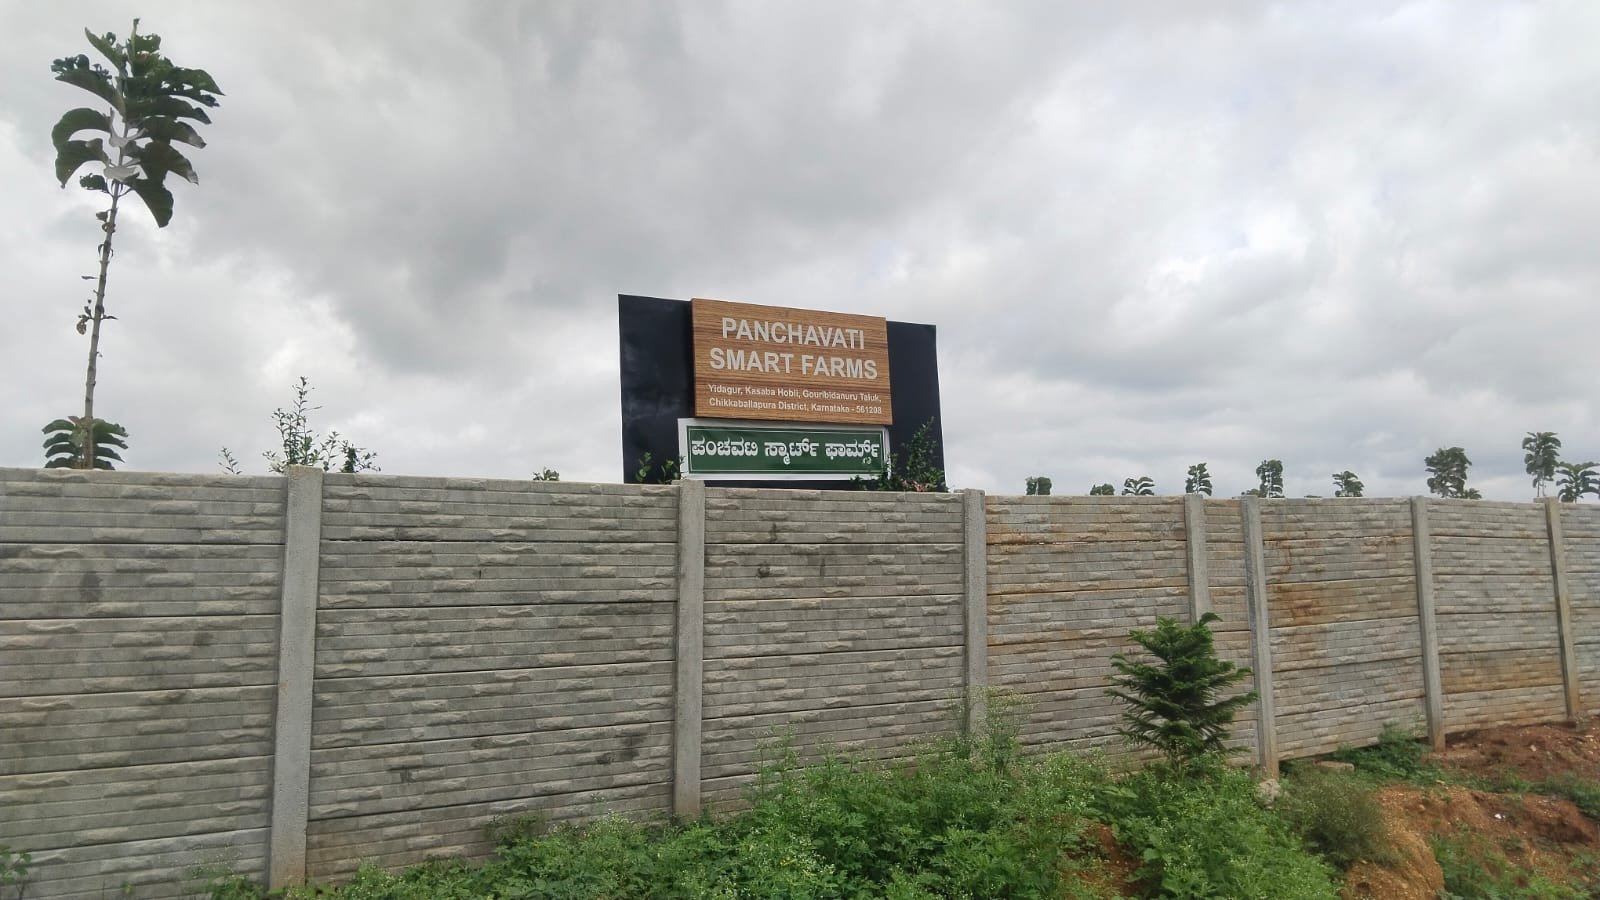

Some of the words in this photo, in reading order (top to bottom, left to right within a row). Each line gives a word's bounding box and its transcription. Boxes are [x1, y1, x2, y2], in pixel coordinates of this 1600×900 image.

[722, 317, 865, 350] PANCHAVATI
[710, 347, 794, 373] SMART
[801, 354, 878, 380] FARMS
[745, 386, 776, 396] Kasaba
[777, 388, 801, 399] Hobli,
[802, 390, 858, 401] Gouribidanuru
[860, 393, 882, 402] Taluk,
[709, 397, 777, 410] Chikkaballapura
[811, 404, 850, 413] Karnataka
[691, 437, 758, 457] ಪಂಚವಟಿ
